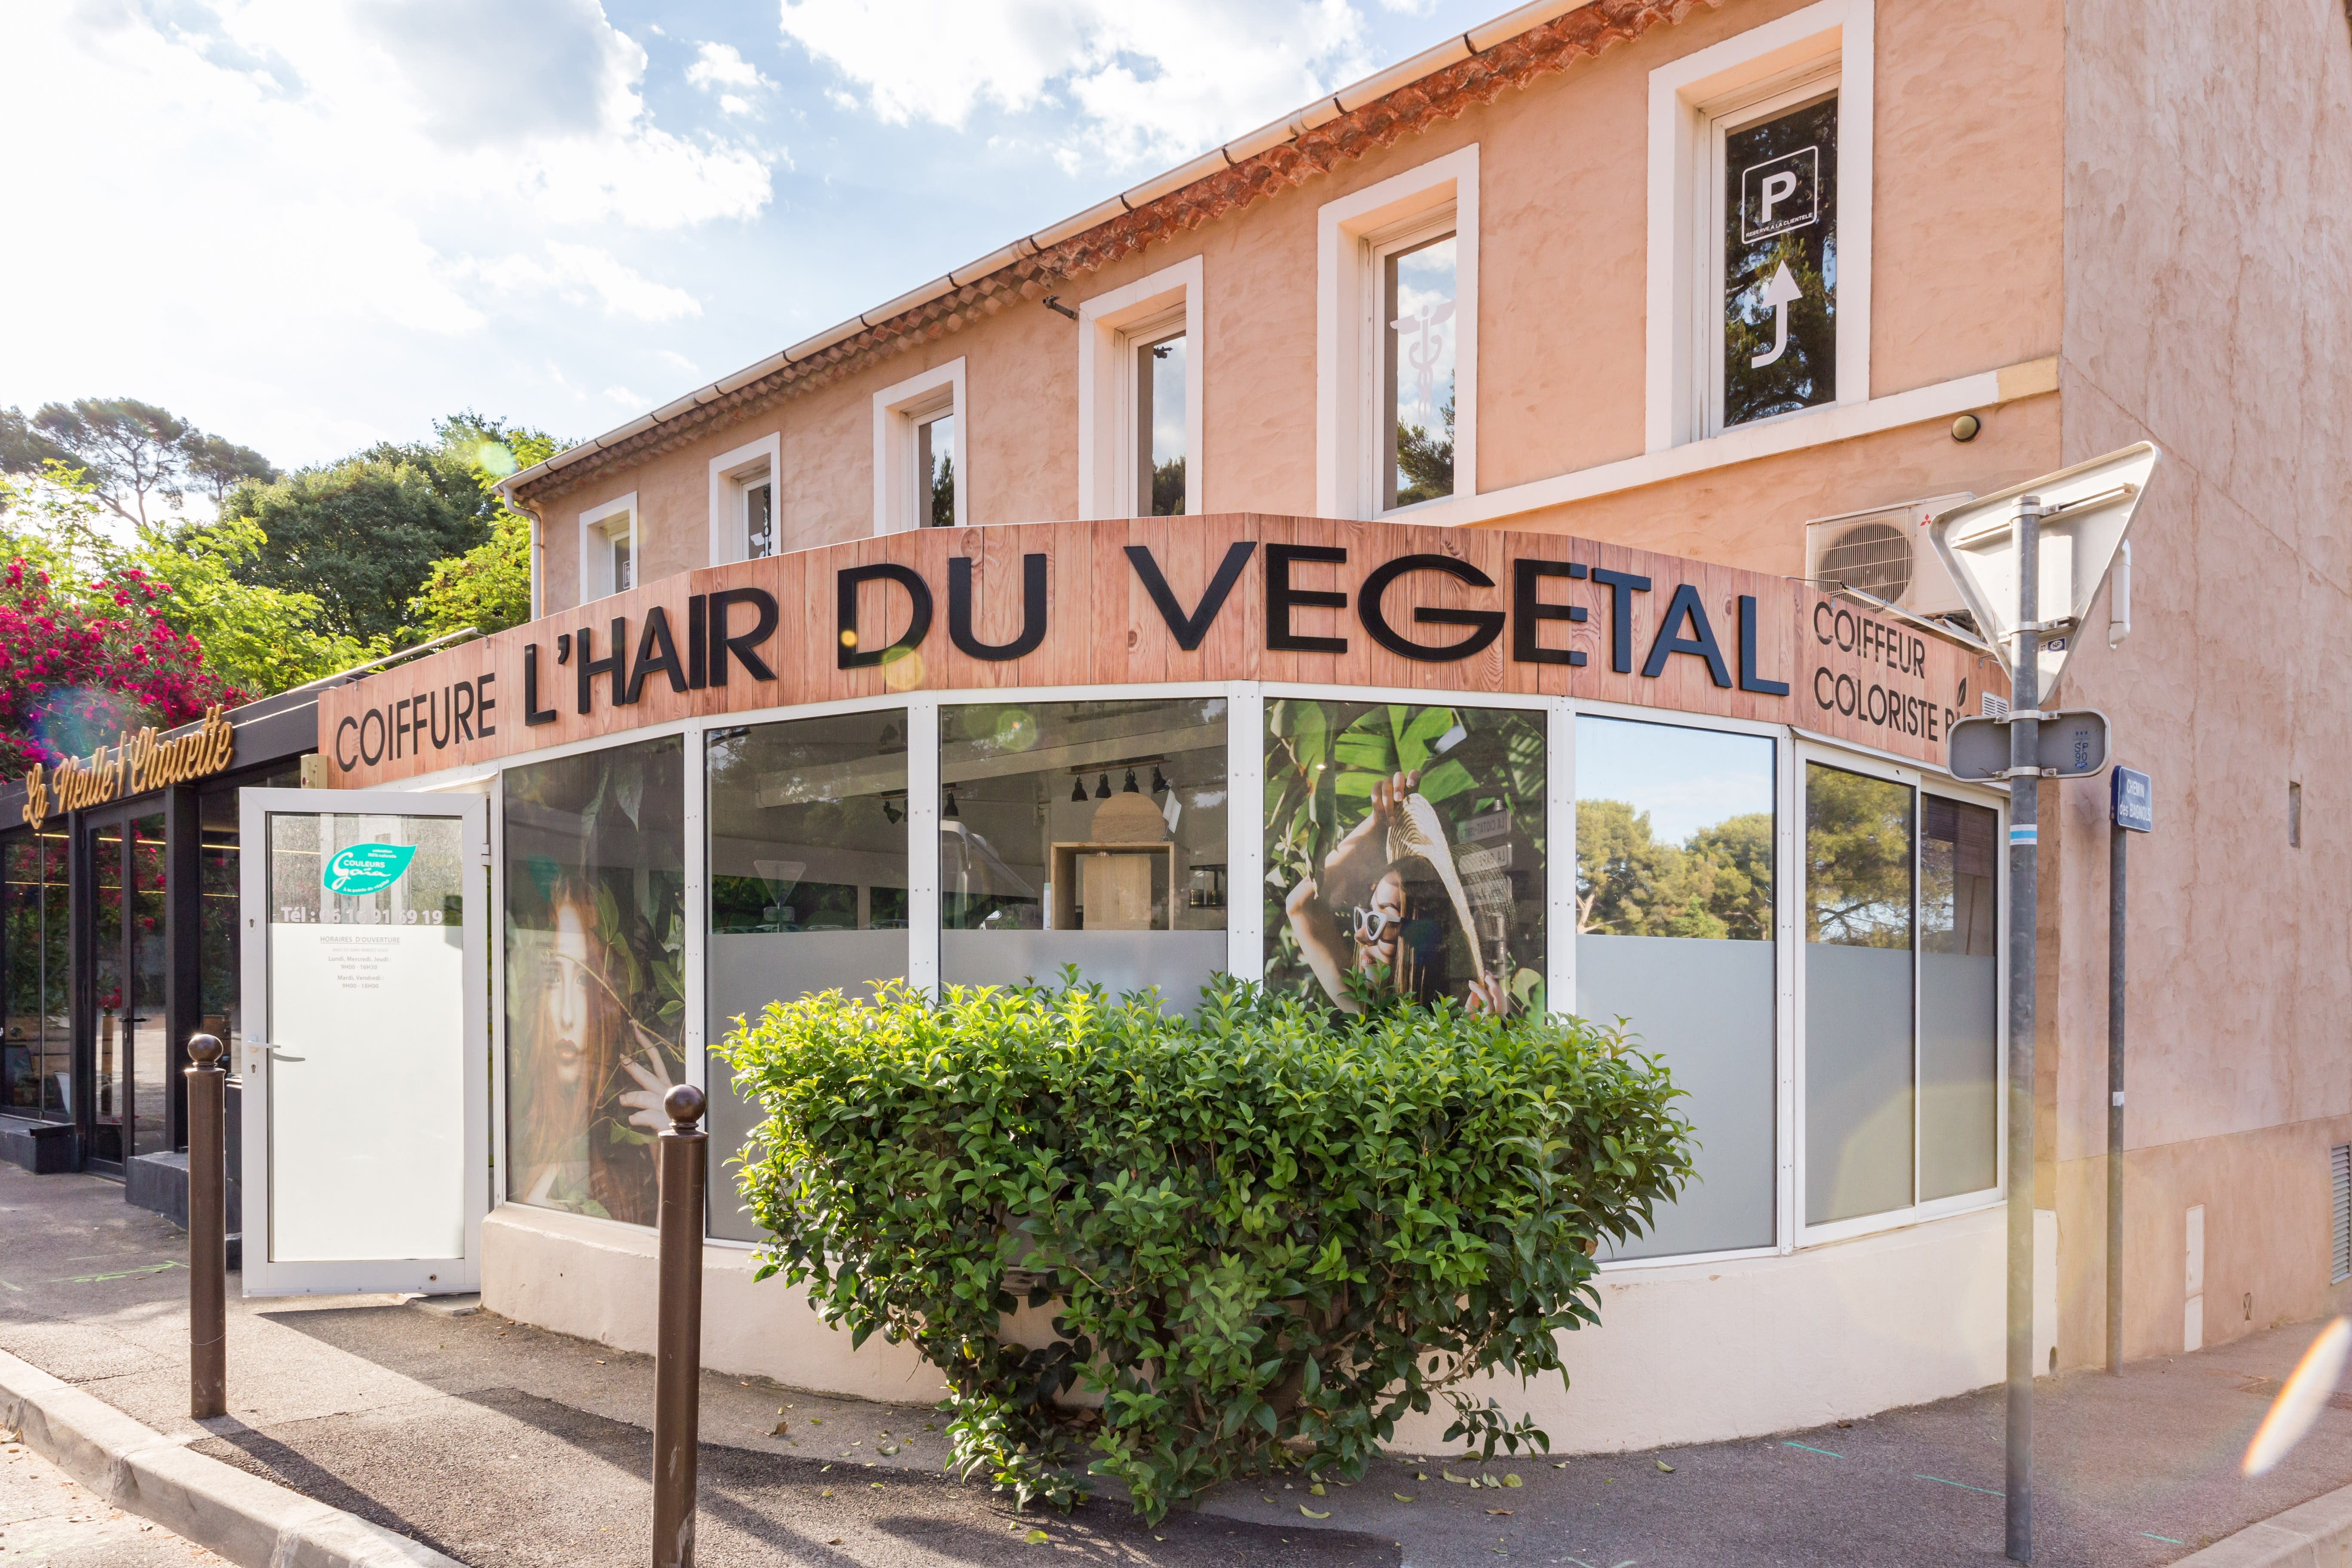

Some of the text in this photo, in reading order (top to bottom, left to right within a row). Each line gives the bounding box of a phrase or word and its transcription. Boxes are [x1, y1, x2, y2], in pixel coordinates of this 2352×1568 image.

[1762, 171, 1797, 223] P
[1746, 226, 1770, 237] RESERVE
[1783, 212, 1813, 226] CLIENTELE
[1813, 601, 1925, 679] COIFFEUR
[336, 541, 1790, 772] COIFFURE L'HAIR DU VEGETAL
[1814, 667, 1938, 742] COLORISTE
[22, 763, 50, 829] La
[130, 703, 234, 794] Chouette
[2075, 752, 2087, 762] 90
[2127, 779, 2145, 798] CHEMIN
[2119, 801, 2151, 822] des BAGNOLS
[343, 860, 386, 868] COULEURS
[281, 906, 306, 922] Tél
[319, 908, 341, 923] 06
[346, 909, 367, 924] 16
[371, 909, 390, 924] 91
[398, 910, 417, 924] 69
[423, 910, 443, 925] 19
